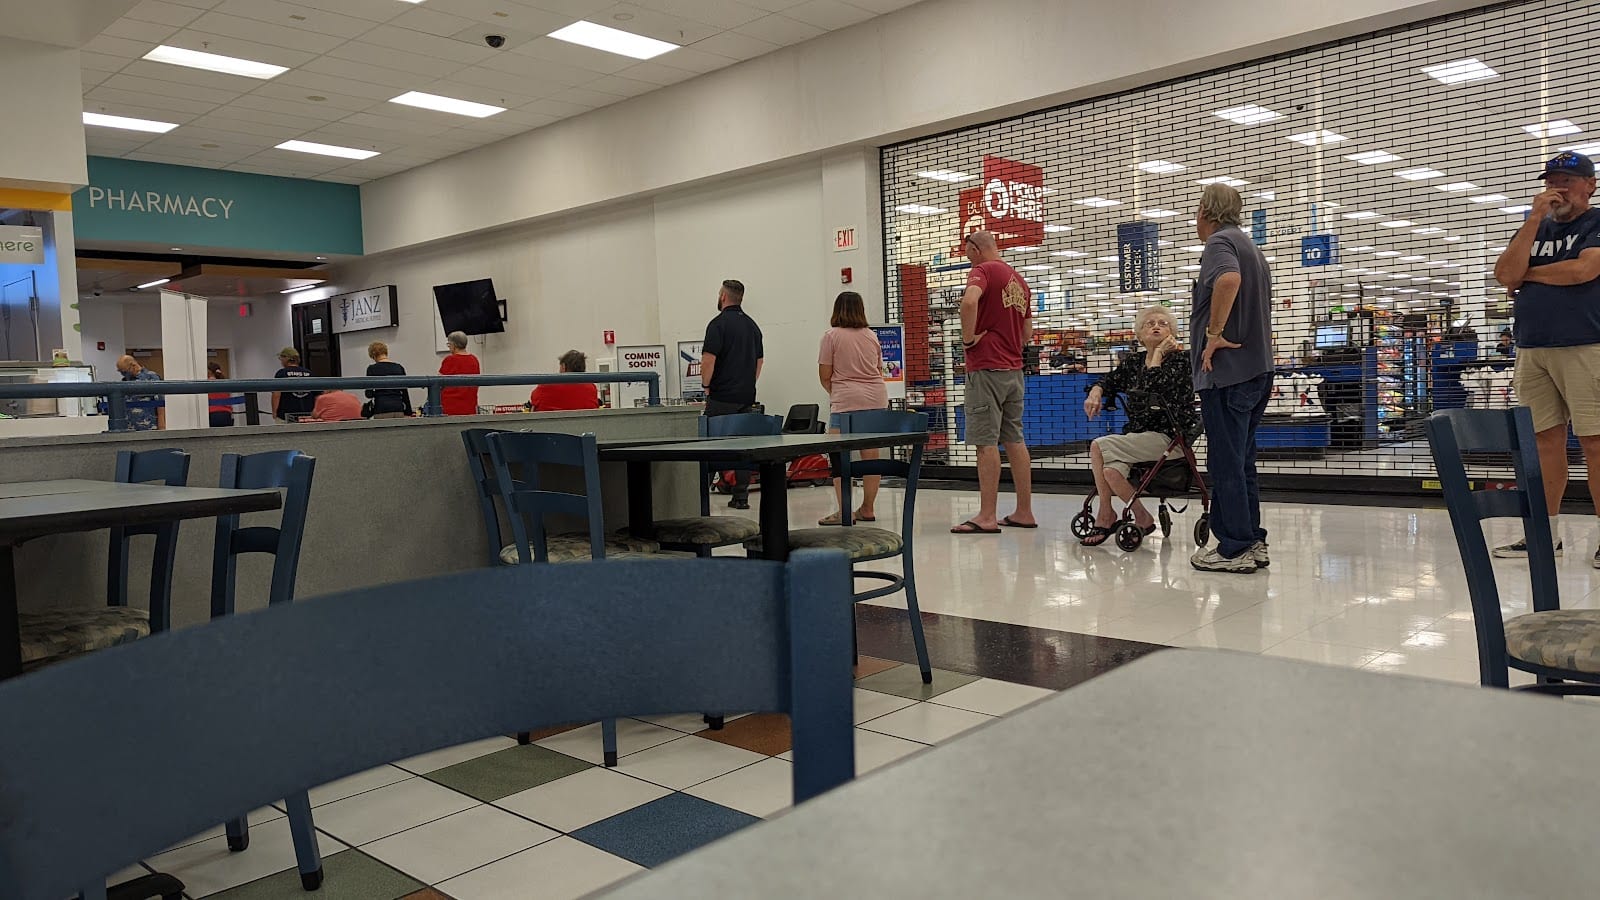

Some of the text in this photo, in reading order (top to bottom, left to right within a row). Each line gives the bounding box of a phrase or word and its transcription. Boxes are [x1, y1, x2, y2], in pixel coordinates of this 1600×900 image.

[89, 187, 234, 219] PHARMACY
[837, 228, 855, 247] EXIT
[1305, 247, 1321, 259] 10
[351, 294, 381, 321] JANZ
[624, 352, 661, 361] COMING
[628, 360, 657, 369] SOON!
